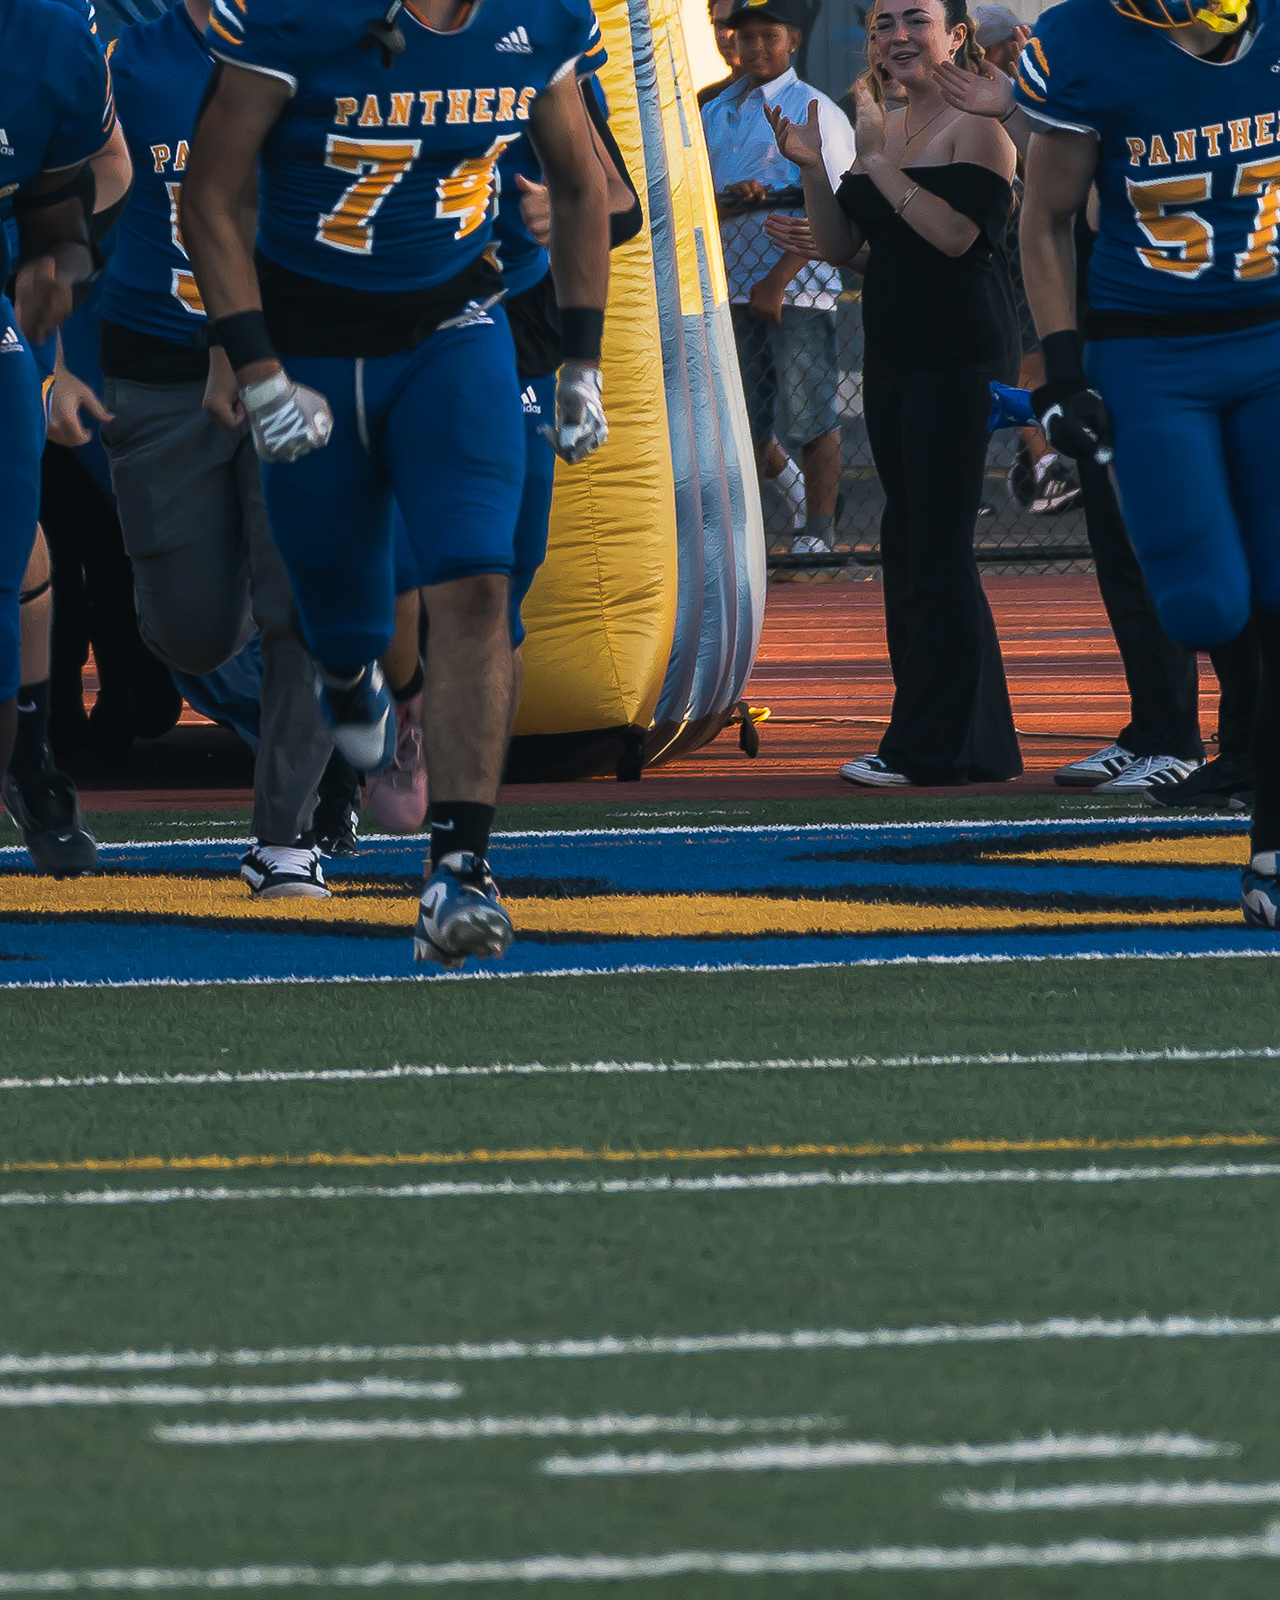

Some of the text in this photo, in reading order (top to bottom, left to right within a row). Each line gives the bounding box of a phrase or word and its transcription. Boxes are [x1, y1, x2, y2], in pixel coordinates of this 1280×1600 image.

[334, 86, 538, 127] PANTHERS
[1125, 110, 1280, 166] PANTHE
[315, 131, 523, 256] 74
[1124, 155, 1280, 282] 57
